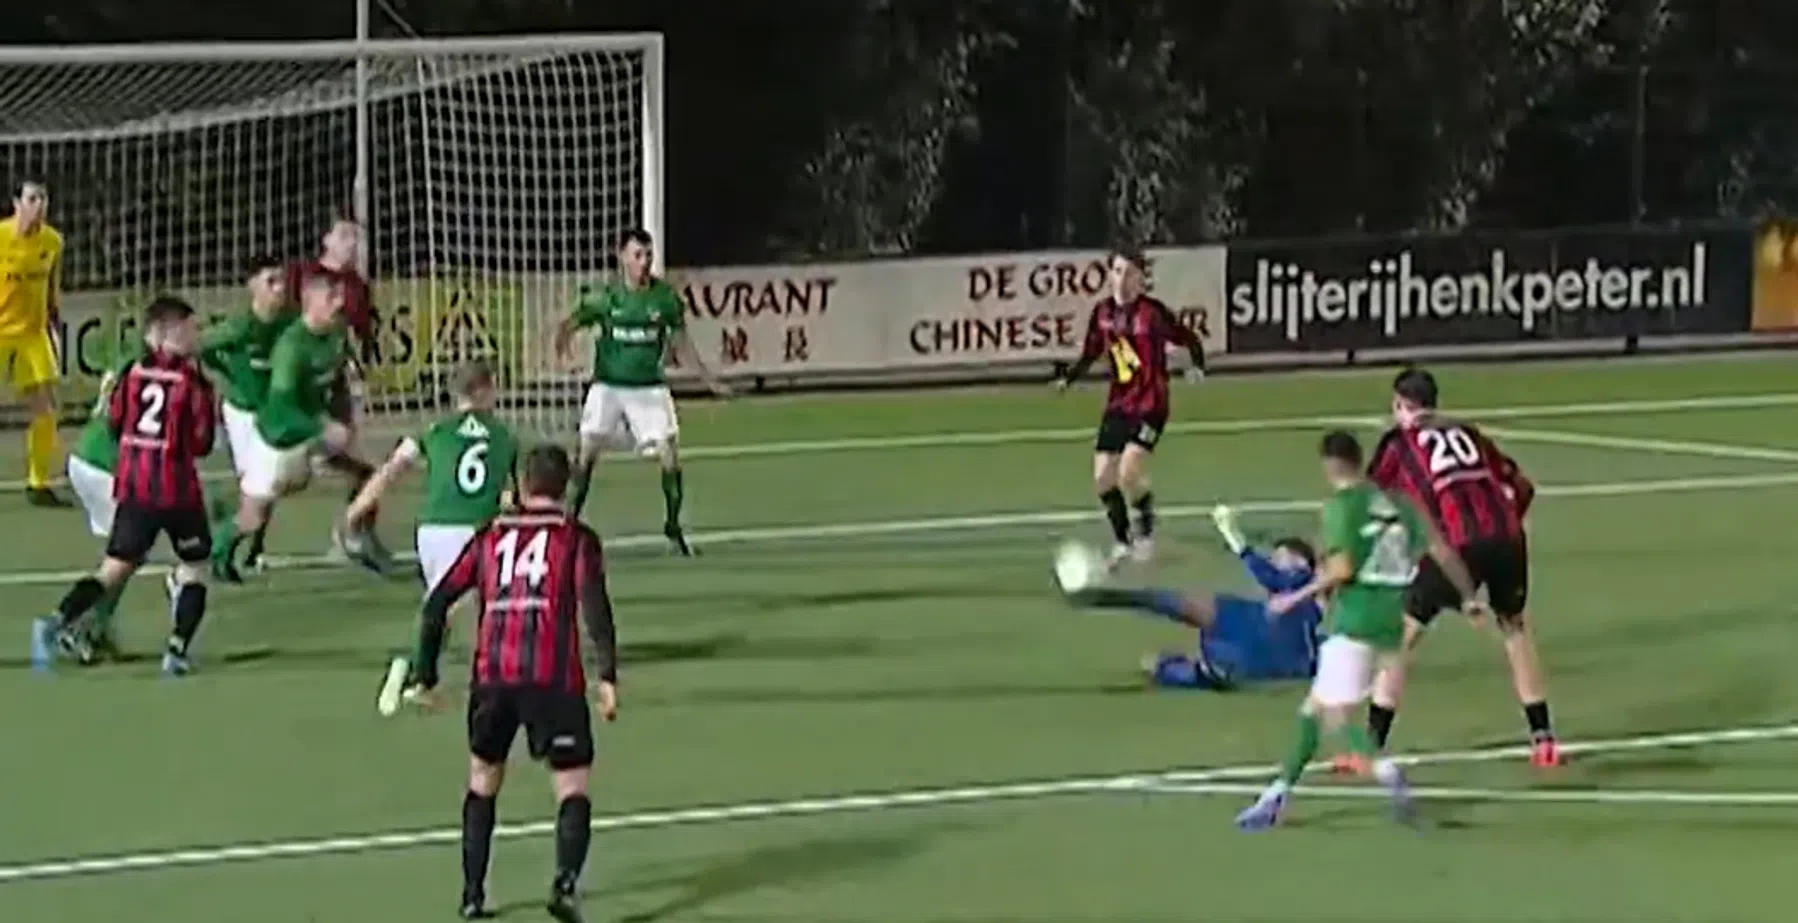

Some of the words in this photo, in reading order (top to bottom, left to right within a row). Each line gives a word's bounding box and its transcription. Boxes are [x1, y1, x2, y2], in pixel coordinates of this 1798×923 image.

[969, 265, 1017, 300] DE
[1231, 242, 1706, 341] slijterijhenkpeter.nl
[910, 312, 1077, 354] CHINESE
[137, 383, 165, 434] 2
[457, 443, 489, 494] 6
[1417, 427, 1480, 473] 20
[494, 528, 549, 588] 14
